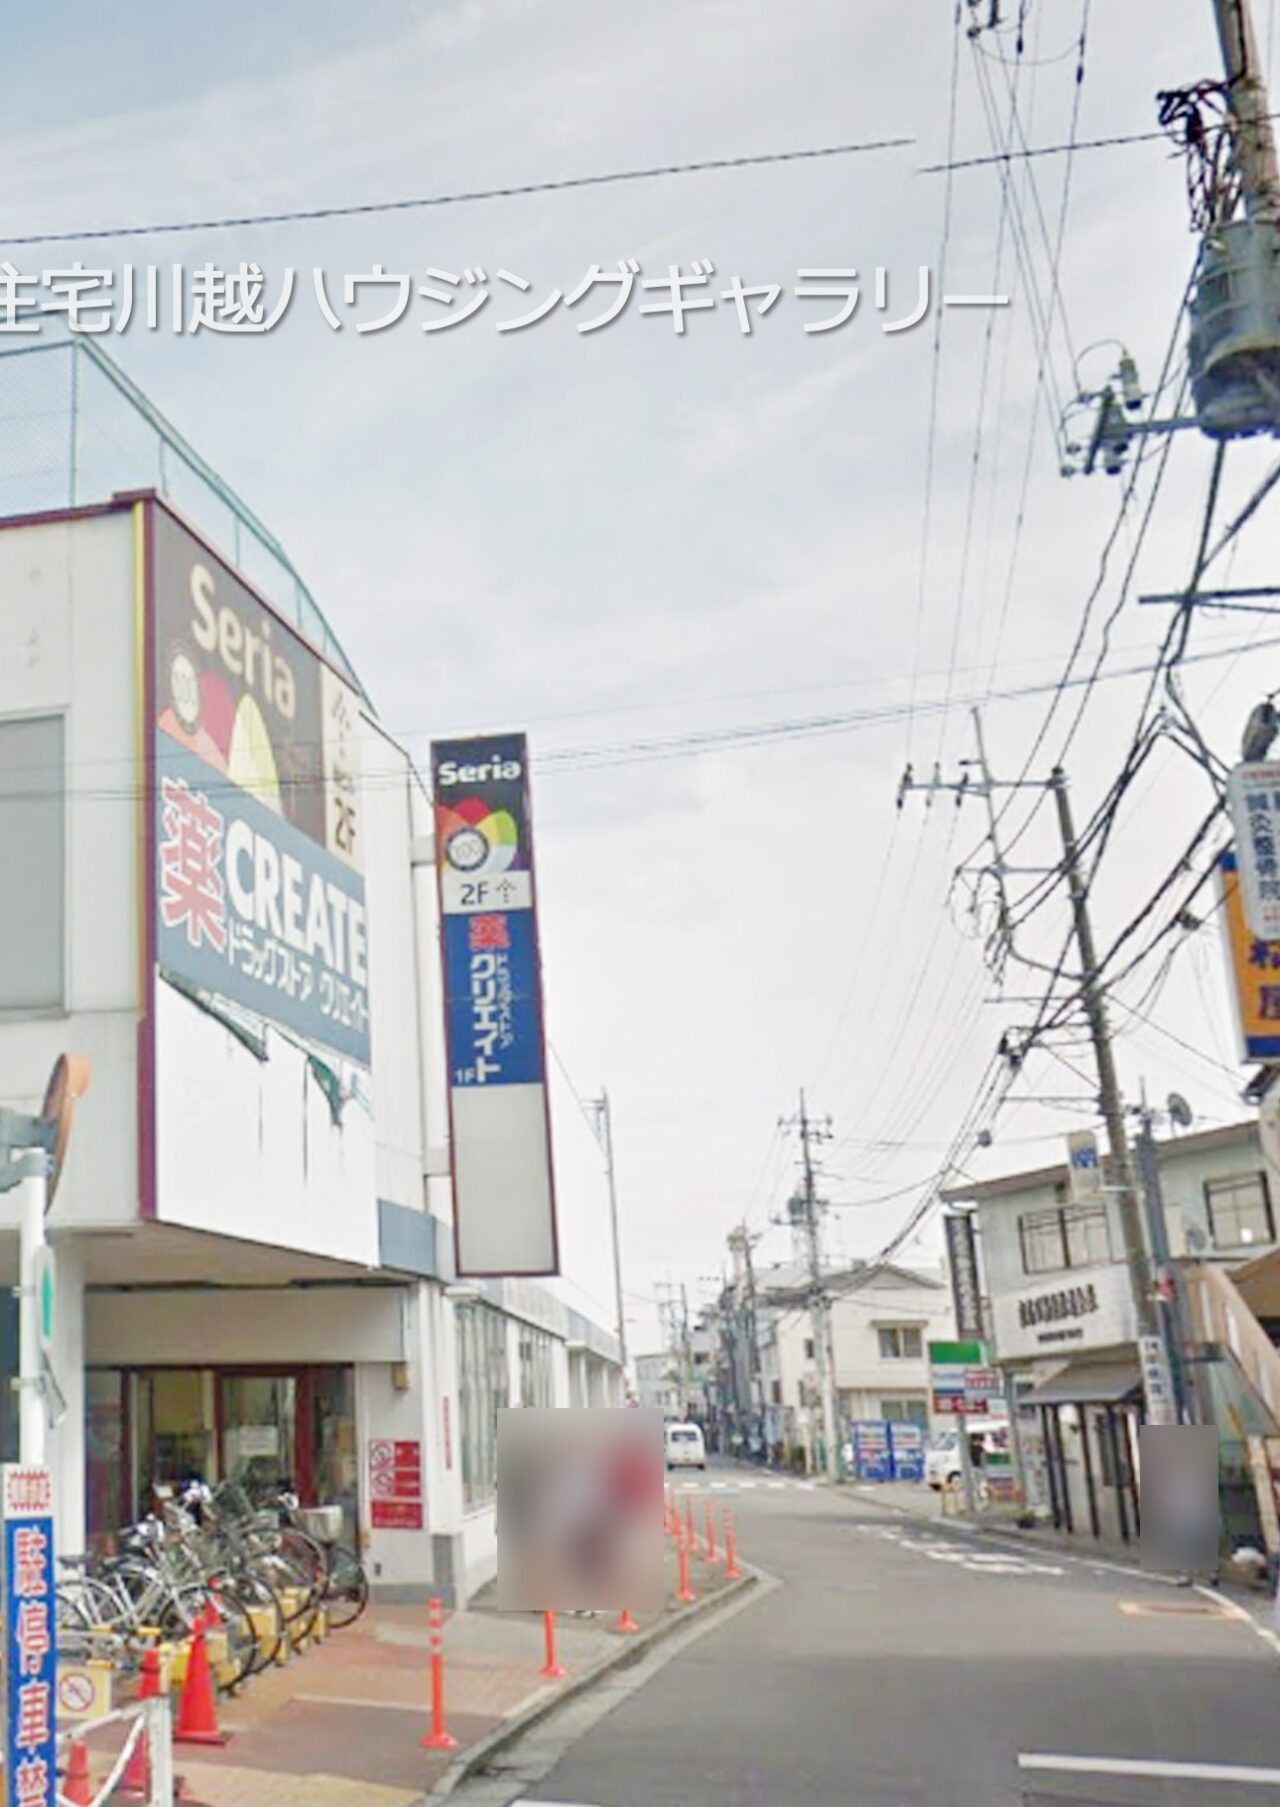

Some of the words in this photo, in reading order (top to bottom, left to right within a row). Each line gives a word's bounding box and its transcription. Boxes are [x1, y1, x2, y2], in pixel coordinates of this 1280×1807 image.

[190, 563, 297, 720] Seria
[438, 755, 521, 786] Seria
[159, 776, 227, 954] 薬
[225, 819, 368, 988] CREATE
[460, 881, 488, 905] 2F
[455, 1067, 476, 1084] 1F
[471, 953, 501, 1083] クリエイト
